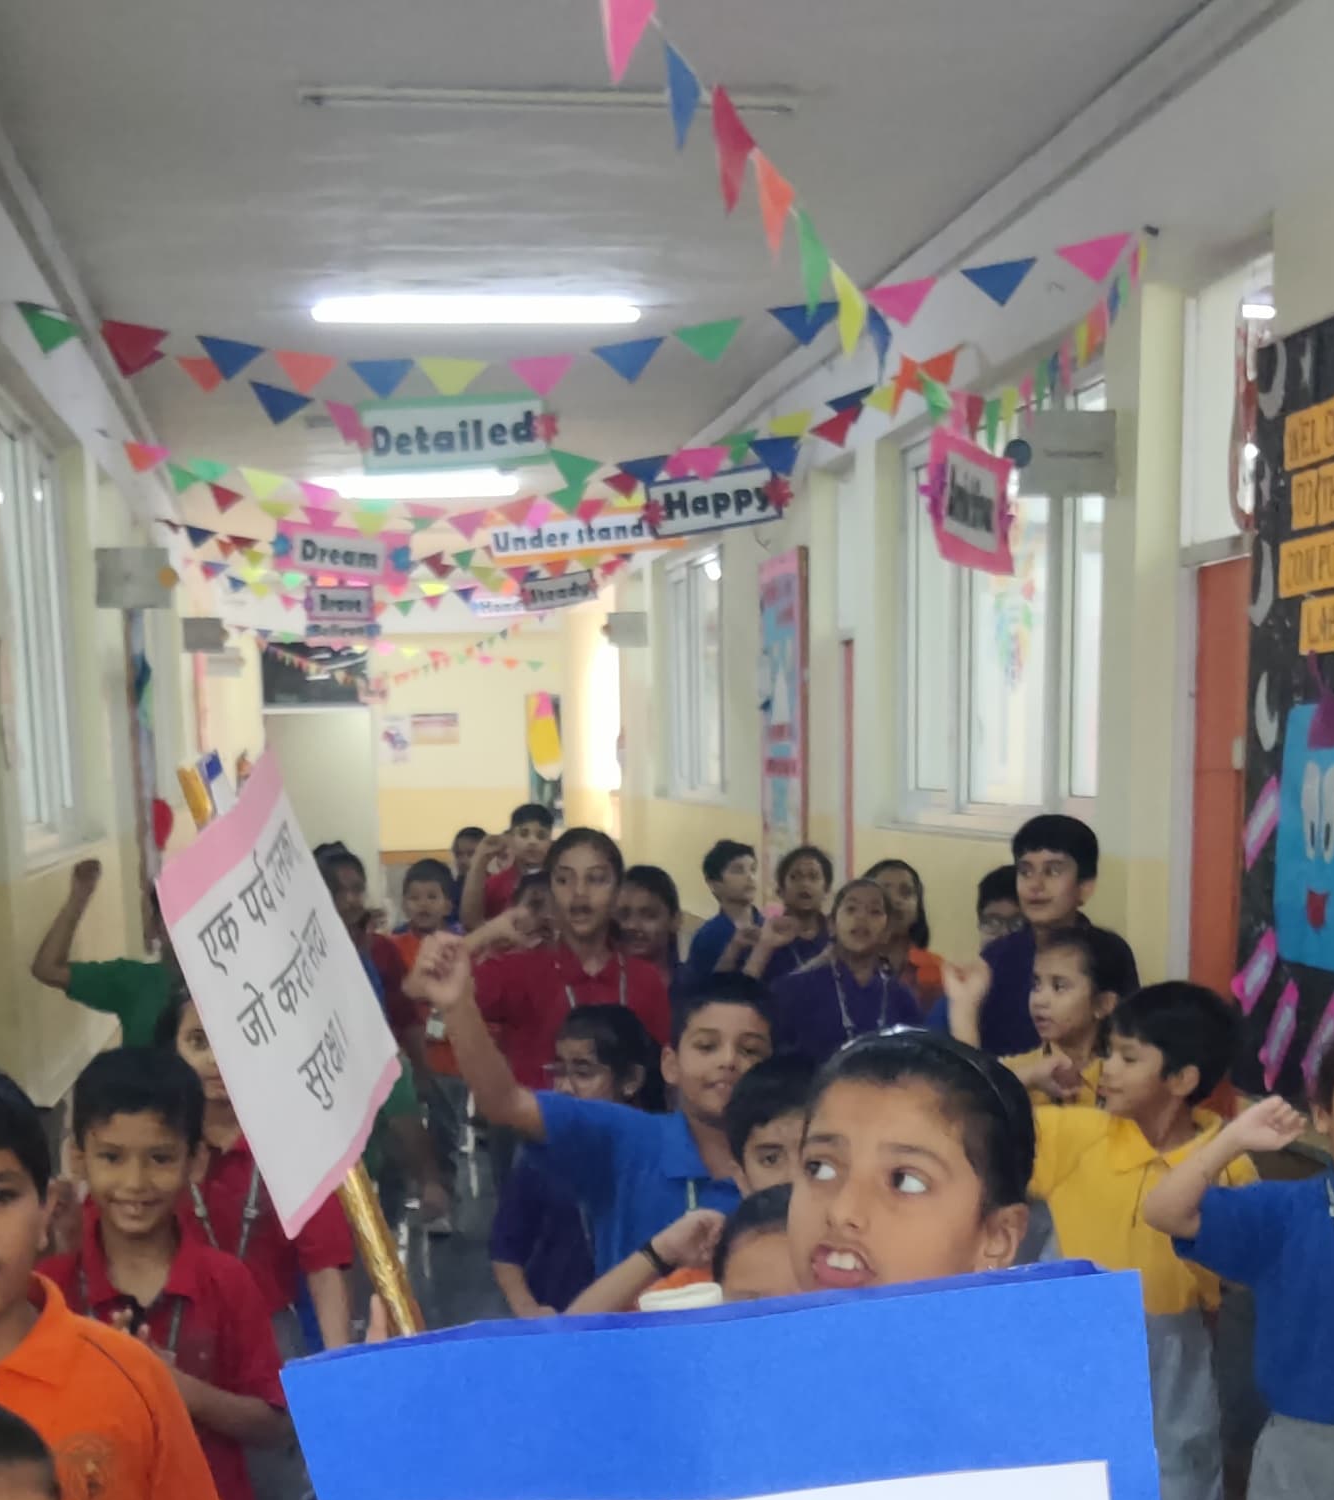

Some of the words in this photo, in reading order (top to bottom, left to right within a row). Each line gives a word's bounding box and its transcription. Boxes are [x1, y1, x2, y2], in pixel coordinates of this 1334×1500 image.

[371, 410, 535, 457] Detailed
[663, 486, 771, 522] Happy
[301, 538, 378, 570] Dream
[197, 901, 241, 976] एक
[238, 848, 277, 927] पर्व
[237, 981, 278, 1047] जो
[269, 930, 315, 1016] करते
